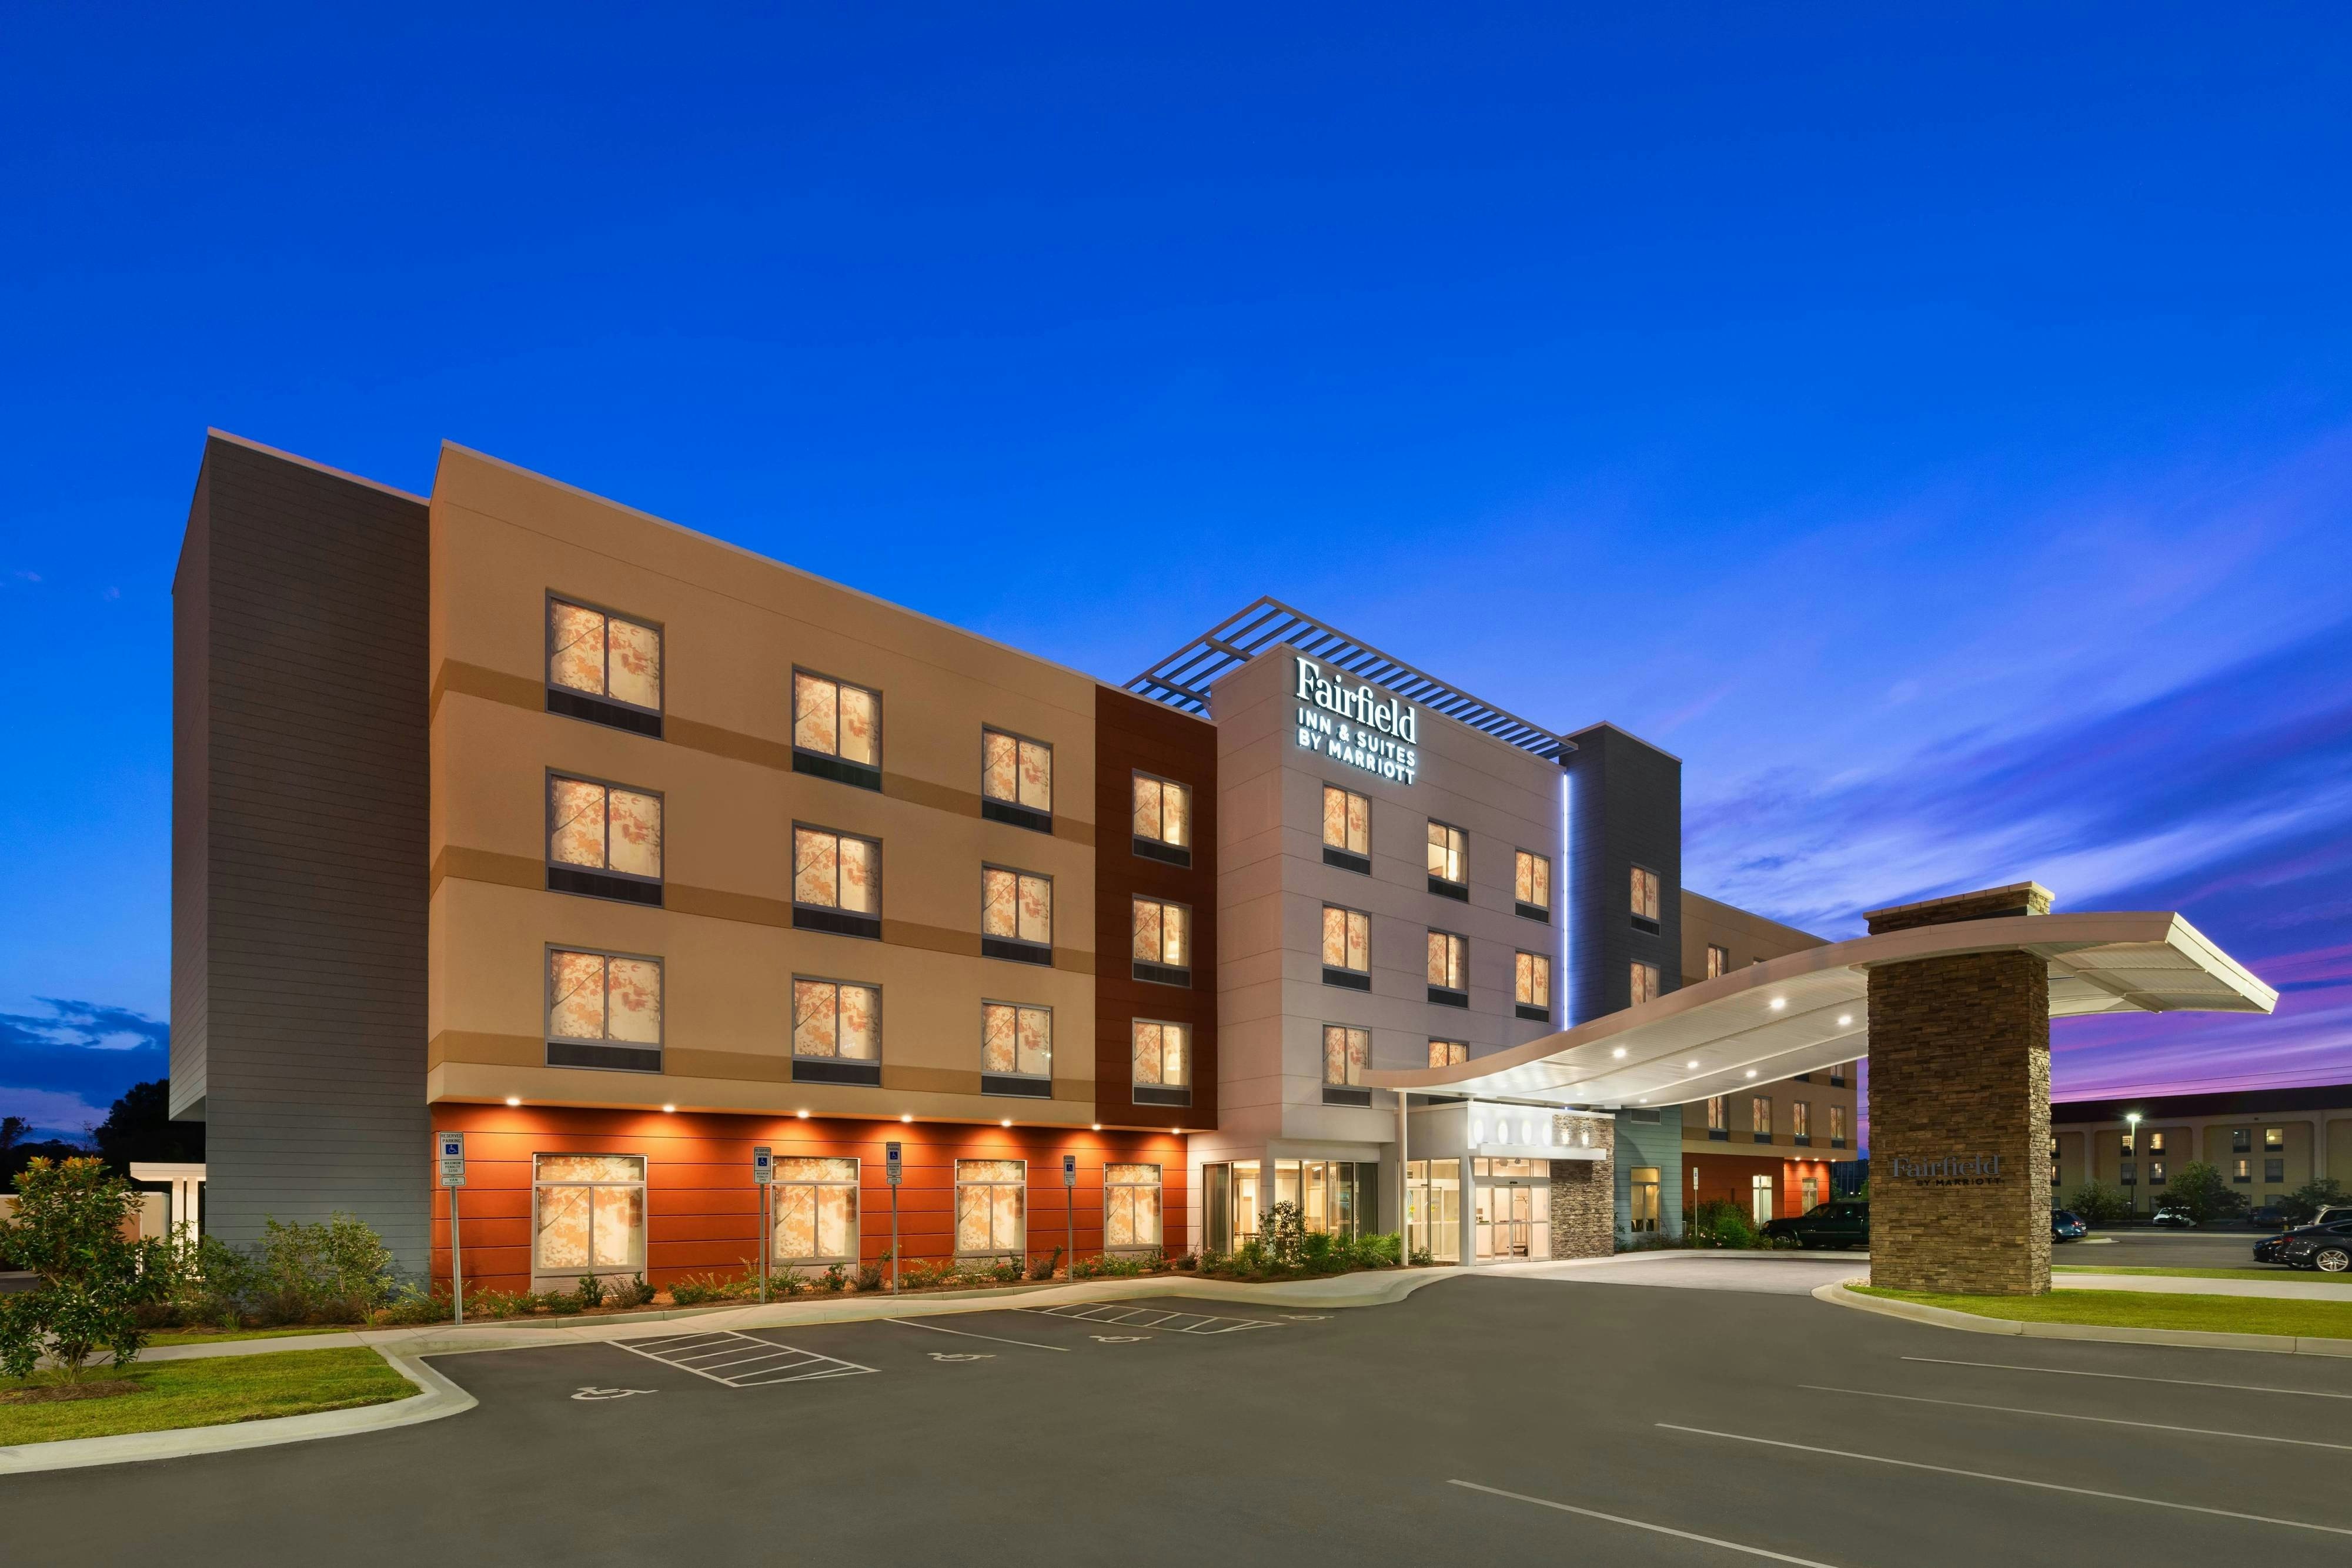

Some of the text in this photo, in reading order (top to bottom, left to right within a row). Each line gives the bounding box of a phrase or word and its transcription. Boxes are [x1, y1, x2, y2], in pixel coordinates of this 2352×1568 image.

[1297, 657, 1416, 744] Fairfield
[1299, 707, 1416, 767] INN & SUITES
[1299, 728, 1415, 785] BY MARRIOTT
[1893, 1154, 2000, 1177] Fairfield
[1936, 1178, 2001, 1186] MARRIOTT
